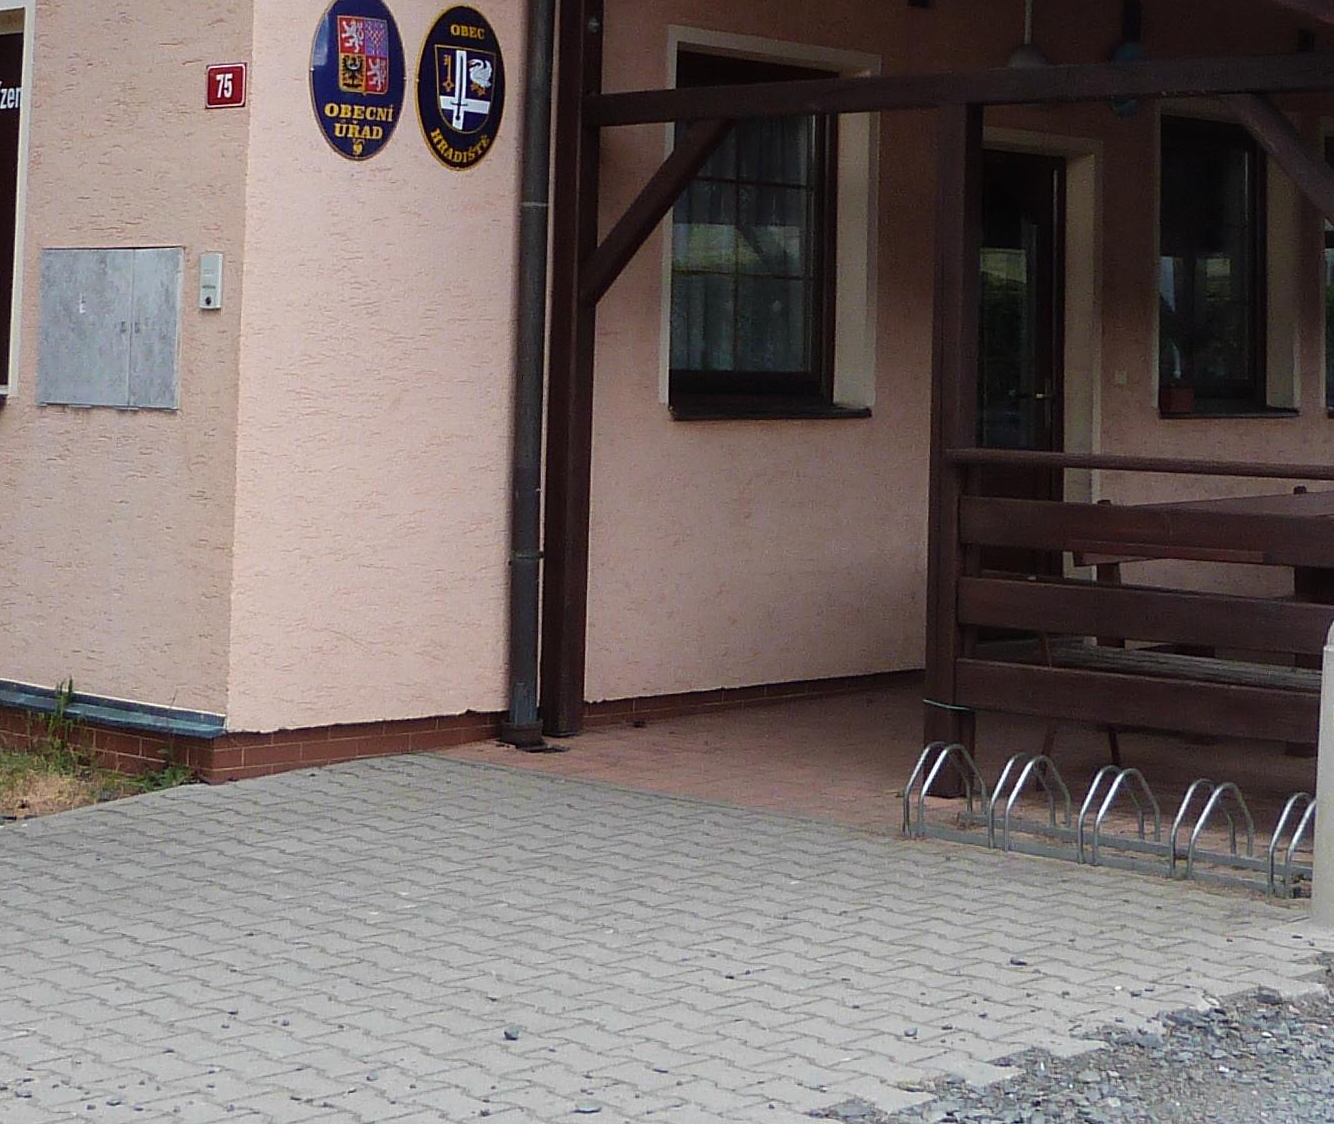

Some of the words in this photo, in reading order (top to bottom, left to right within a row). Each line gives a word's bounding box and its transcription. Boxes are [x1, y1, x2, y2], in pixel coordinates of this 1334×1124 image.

[450, 24, 485, 40] OBEC
[216, 73, 233, 98] 75
[324, 103, 394, 122] OBECNÍ
[334, 119, 383, 140] ÚŘAD
[430, 127, 490, 164] HRADIŠTĚ
